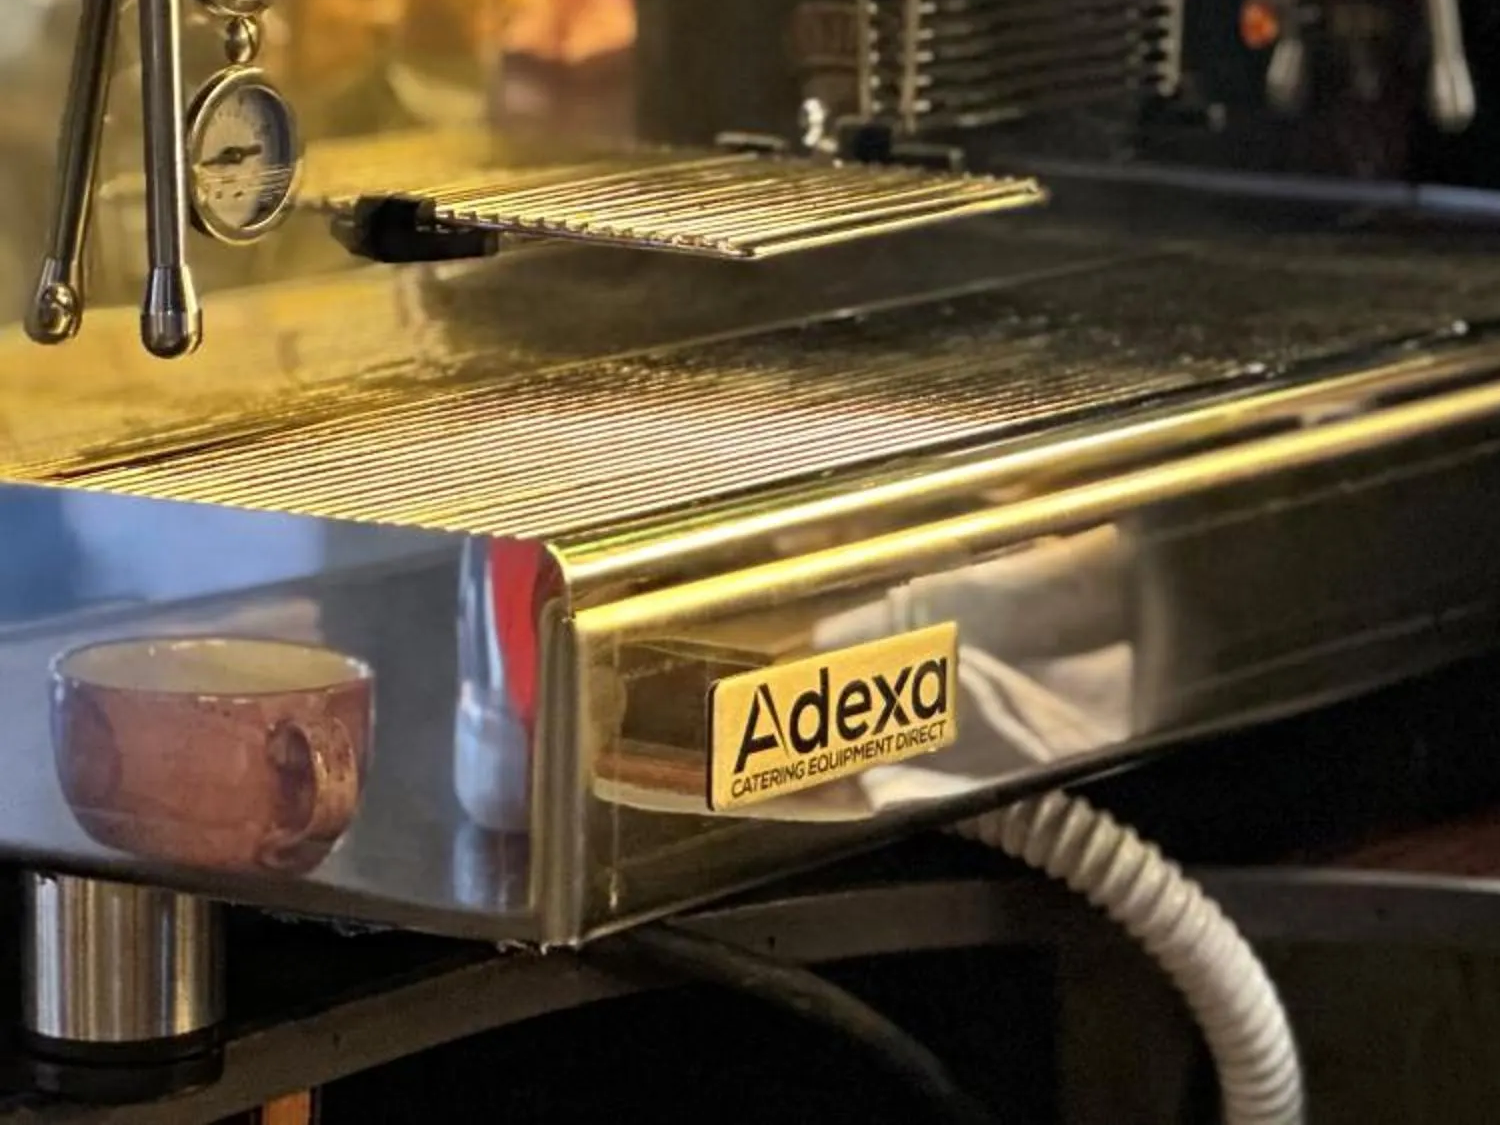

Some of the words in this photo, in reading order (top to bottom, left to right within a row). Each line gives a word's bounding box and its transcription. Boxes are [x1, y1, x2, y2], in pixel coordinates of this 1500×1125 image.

[730, 759, 806, 799] CATERING
[807, 734, 895, 774] EQUIPMENT
[895, 719, 948, 752] DIRECT
[733, 657, 948, 775] Adexa
